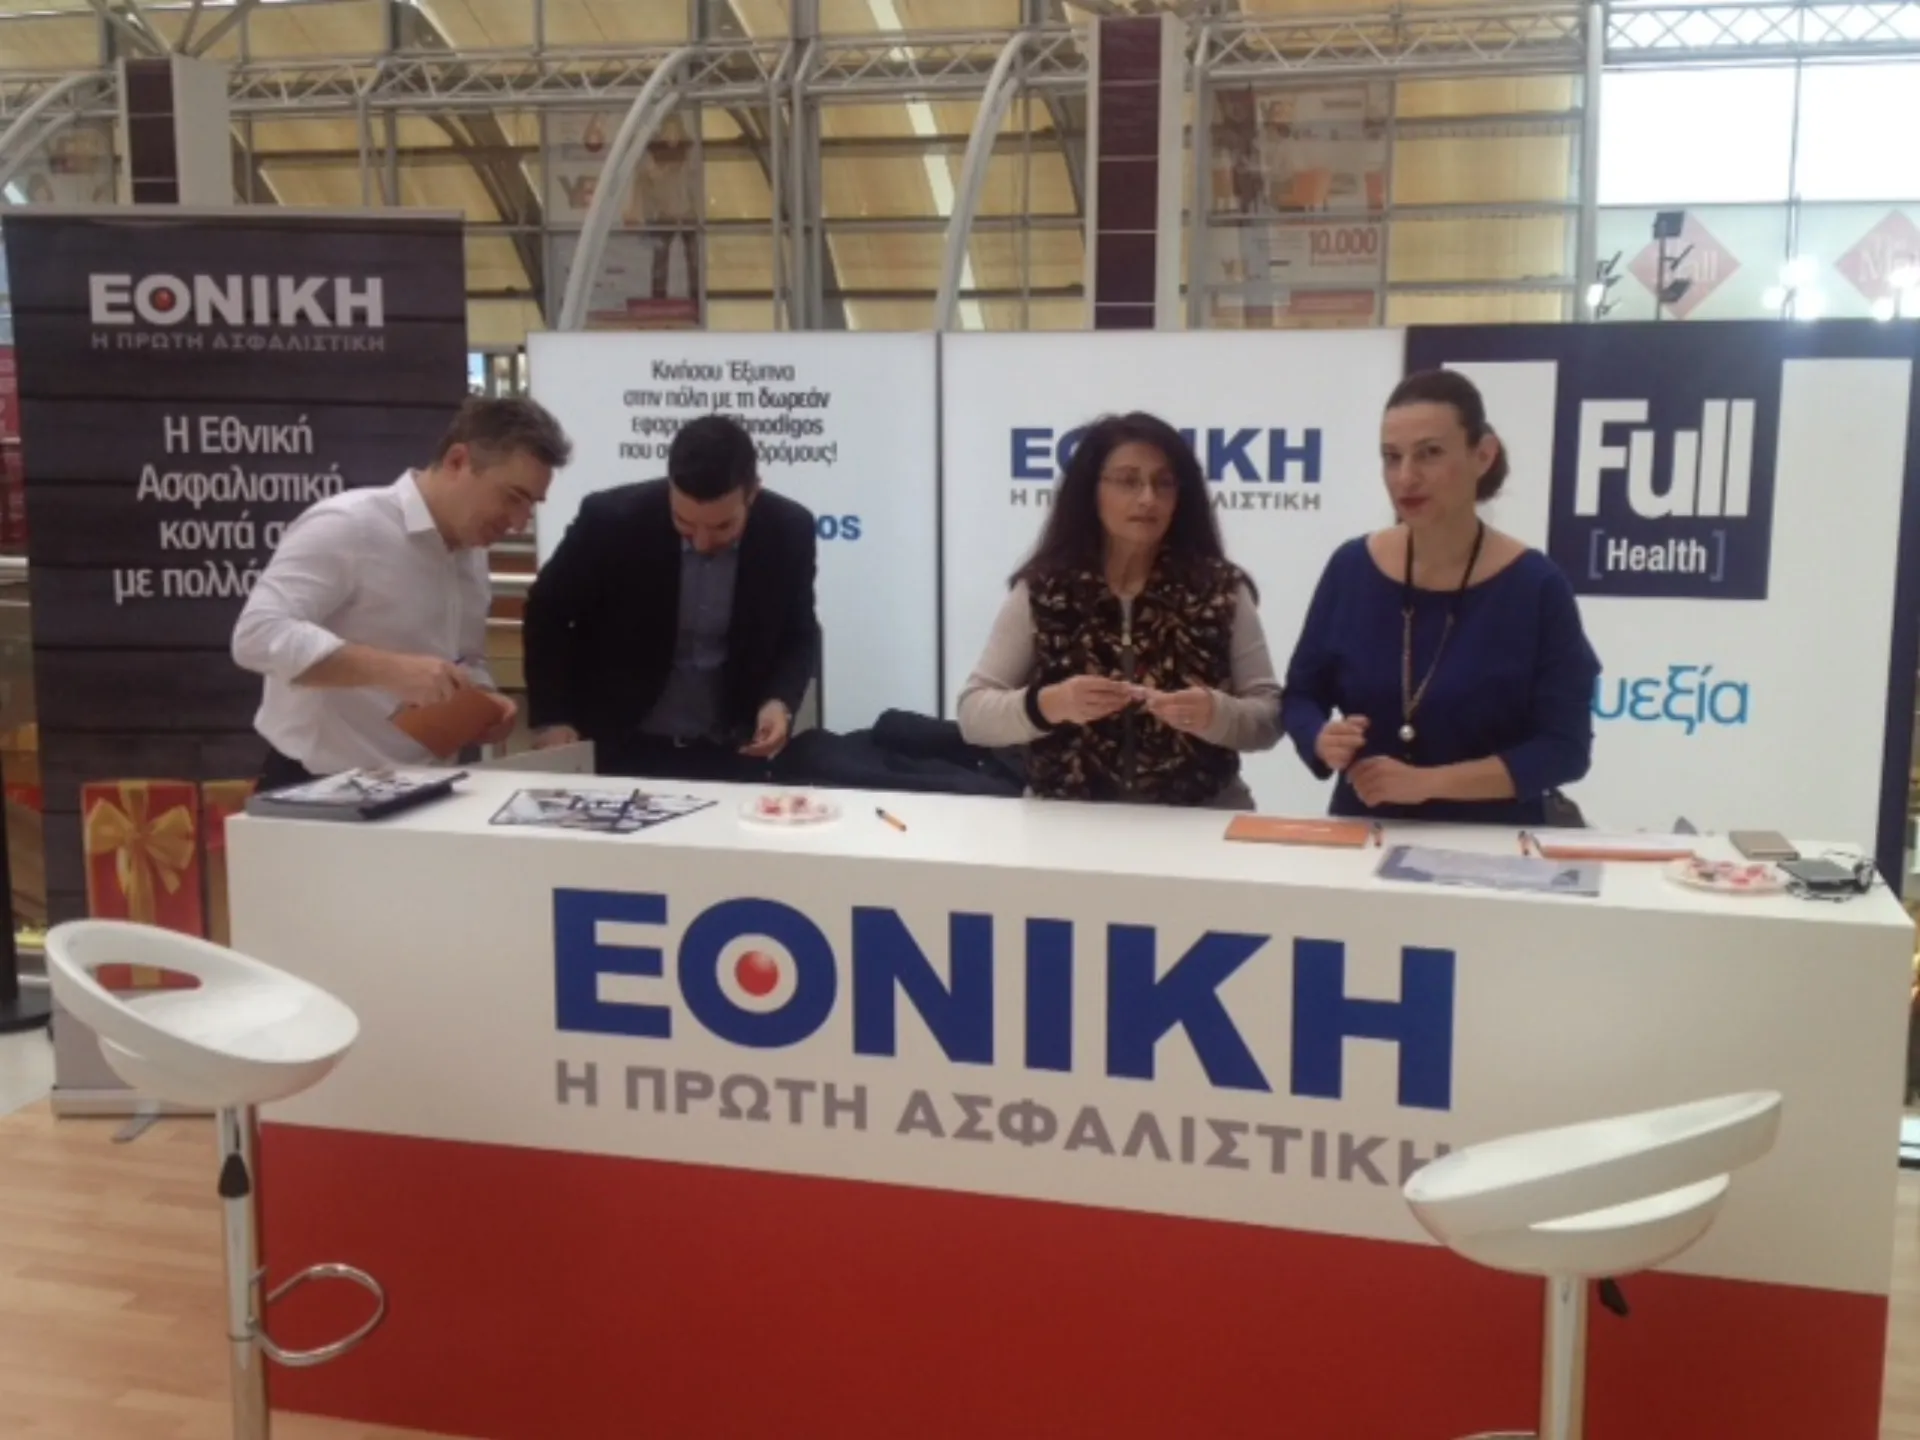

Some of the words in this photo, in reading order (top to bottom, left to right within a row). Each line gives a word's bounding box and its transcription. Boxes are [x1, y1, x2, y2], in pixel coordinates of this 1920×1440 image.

[117, 333, 204, 350] ΠΡΩΤΗ
[212, 333, 385, 353] ΑΣΦΑΛΙΣΤΙΚΗ
[712, 392, 733, 411] με
[758, 386, 830, 411] δωρεάν
[164, 416, 189, 454] Η
[201, 414, 313, 455] Εθνική
[1575, 400, 1756, 518] Full
[137, 464, 345, 511] Ασφαλιστική
[1210, 489, 1322, 511] ΛΙΣΤΙΚΗ
[160, 509, 255, 551] κοντά
[113, 569, 154, 605] με
[1590, 664, 1748, 735] υεξία
[555, 1060, 598, 1108] Η
[625, 1065, 868, 1132] ΠΡΩΤΗ
